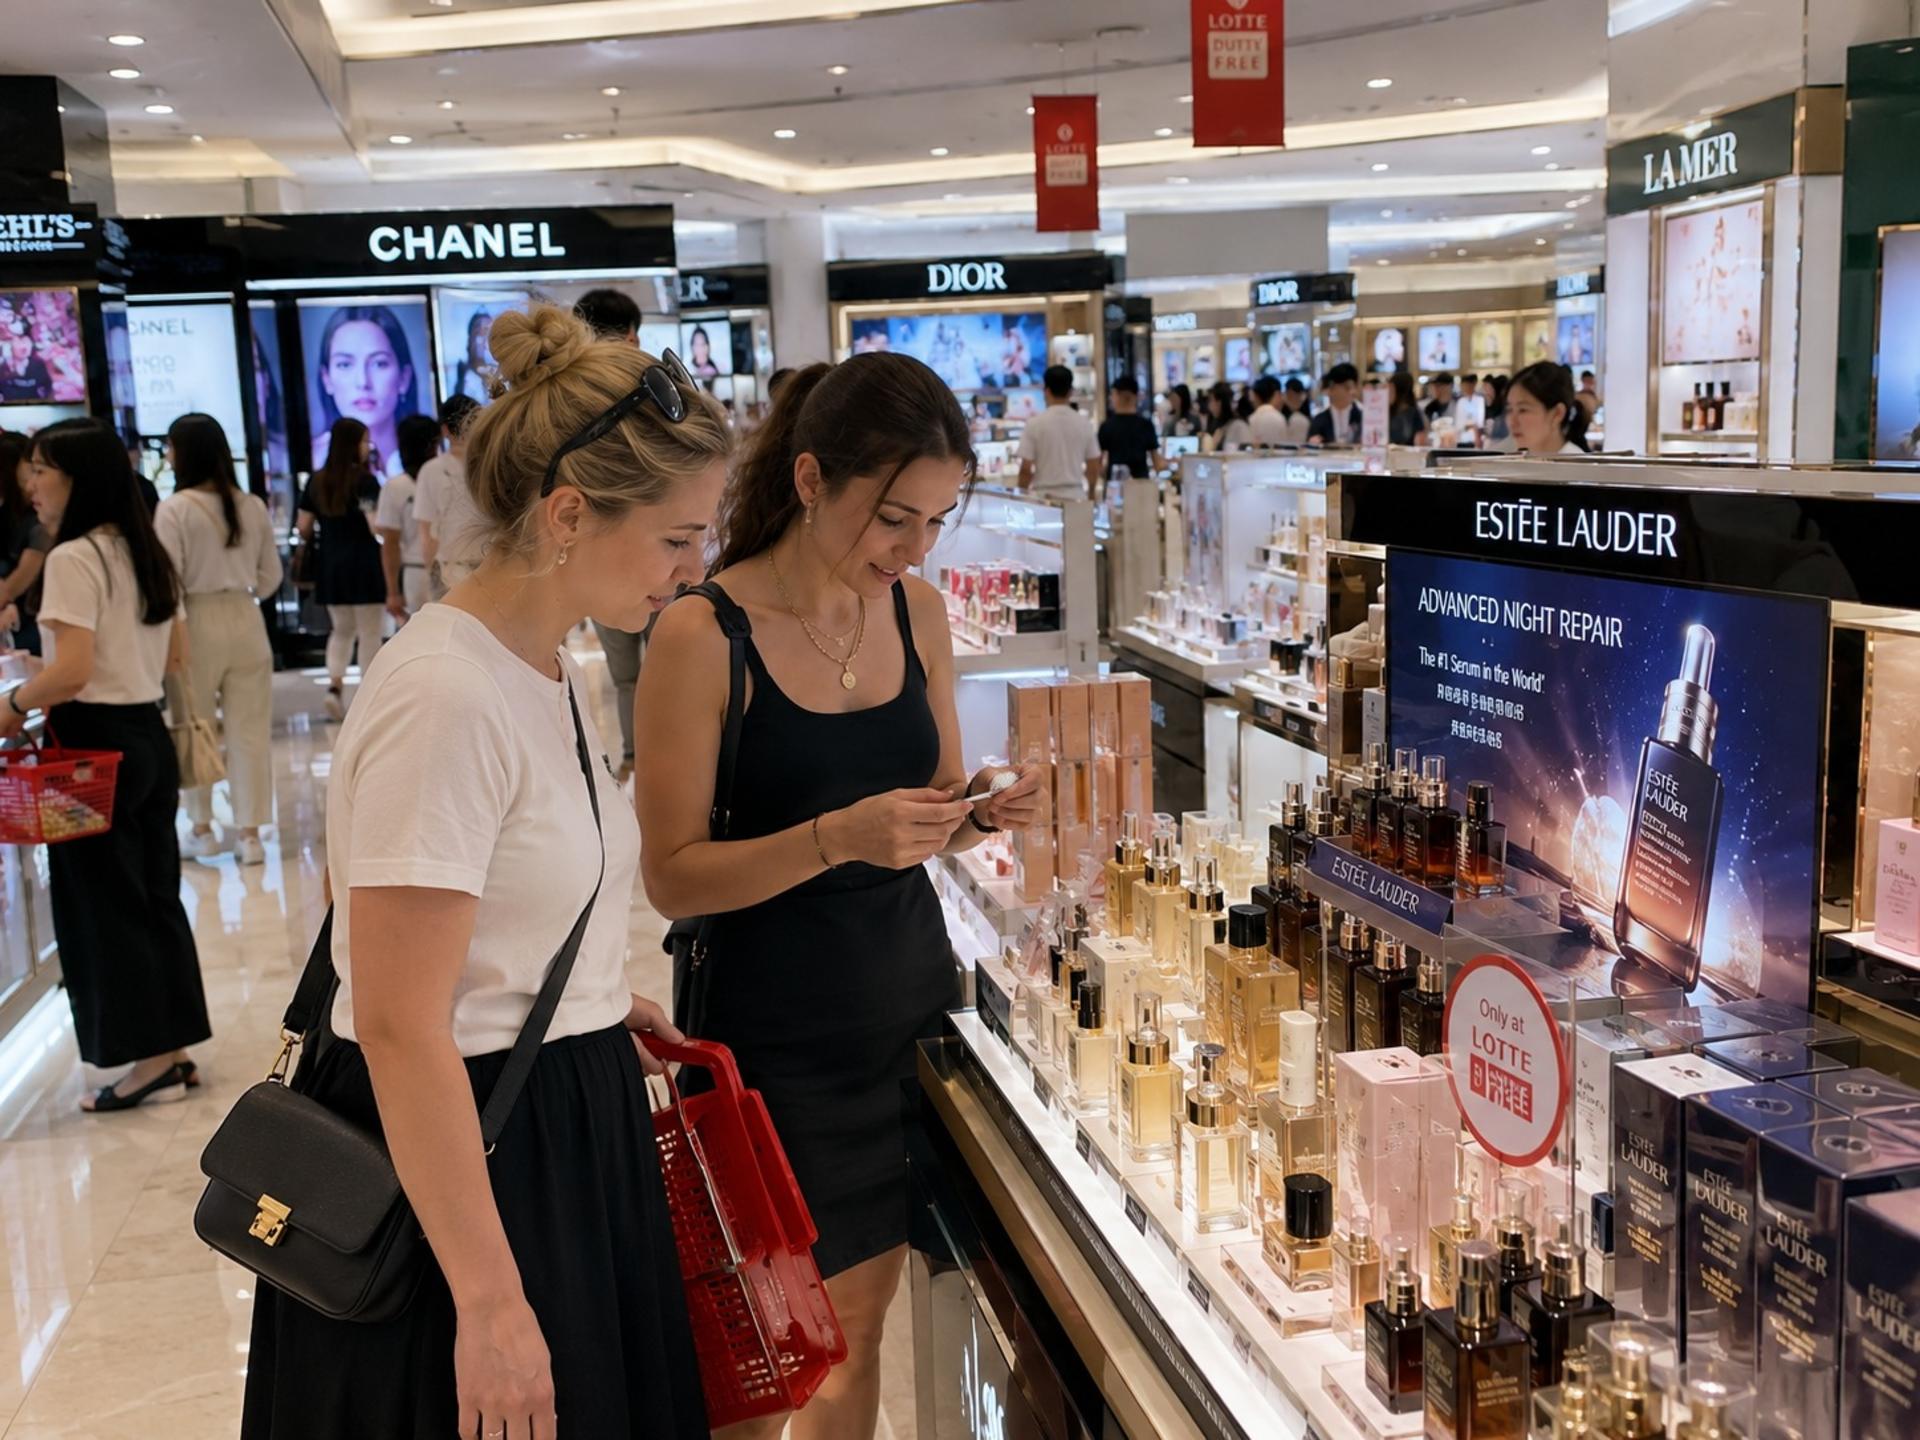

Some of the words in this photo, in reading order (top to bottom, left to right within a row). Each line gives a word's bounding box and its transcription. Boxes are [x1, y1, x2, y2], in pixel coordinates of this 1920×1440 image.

[1208, 13, 1268, 29] LOTTE
[1215, 56, 1260, 71] FREE
[1643, 148, 1677, 195] LA
[1678, 131, 1738, 187] MER
[368, 222, 566, 262] CHANEL
[927, 262, 1008, 292] DIOR
[1258, 281, 1299, 304] DIOR
[1557, 506, 1678, 557] LAUDER
[1418, 587, 1499, 624] ADVANCED
[1503, 600, 1555, 635] NIGHT
[1559, 609, 1623, 648] REPAIR
[1419, 646, 1436, 668] The
[1451, 654, 1481, 678] Serum
[1482, 661, 1492, 681] in
[1494, 663, 1509, 685] the
[1645, 785, 1688, 823] LAUDER
[1369, 875, 1420, 915] LAUDER
[1479, 998, 1508, 1030] Only
[1511, 1015, 1525, 1035] at
[1472, 1025, 1532, 1075] LOTTE
[1621, 1143, 1669, 1186] LAUDER
[1695, 1180, 1749, 1226] LAUDER
[1766, 1226, 1828, 1278] LAUDER
